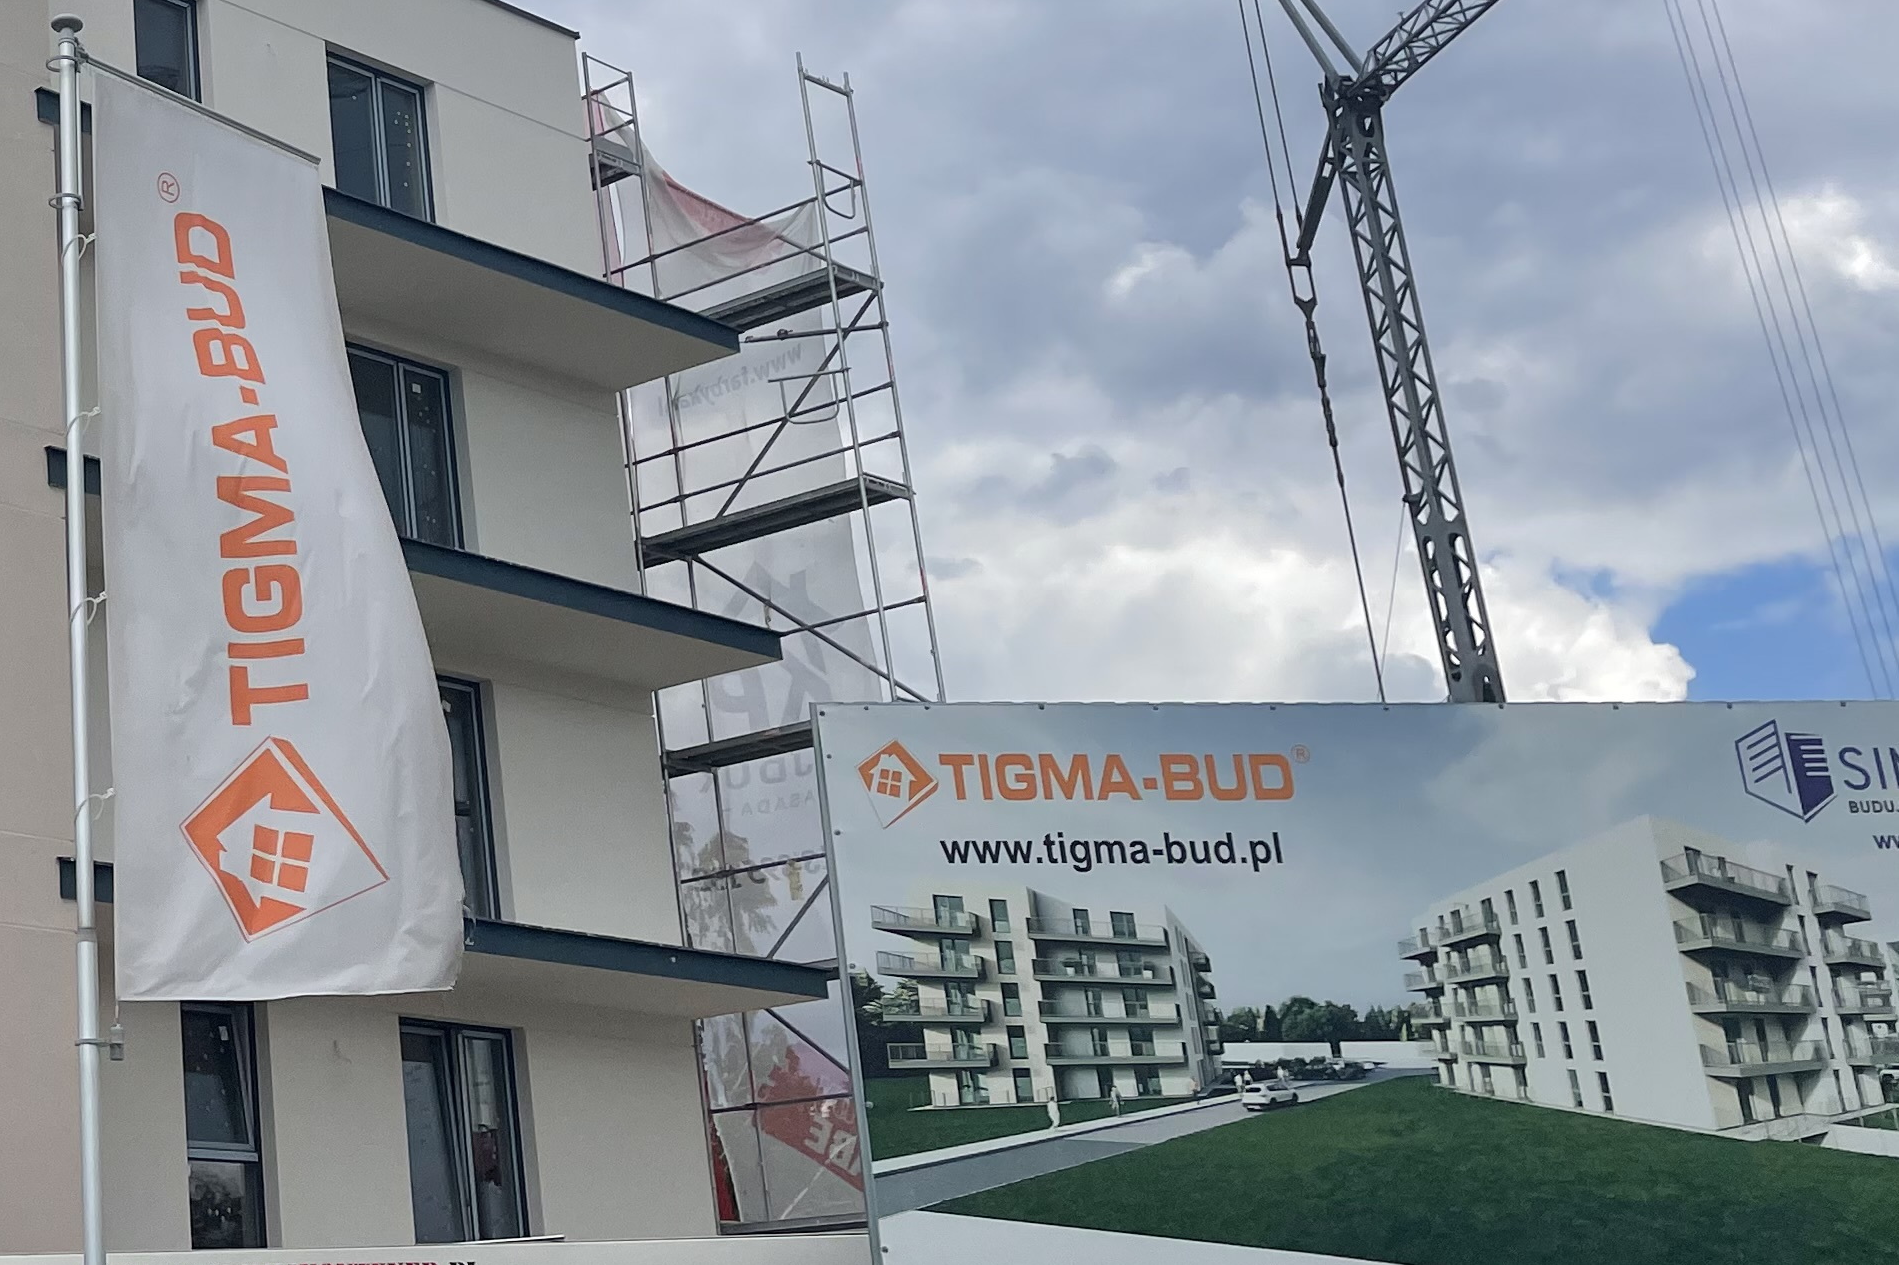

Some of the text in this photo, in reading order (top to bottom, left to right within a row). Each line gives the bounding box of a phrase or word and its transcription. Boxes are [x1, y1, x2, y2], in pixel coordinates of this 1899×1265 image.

[938, 752, 1295, 801] TIGMA-BUD
[1848, 799, 1899, 814] BUDU
[939, 832, 1284, 872] www.tigma-bud.pl
